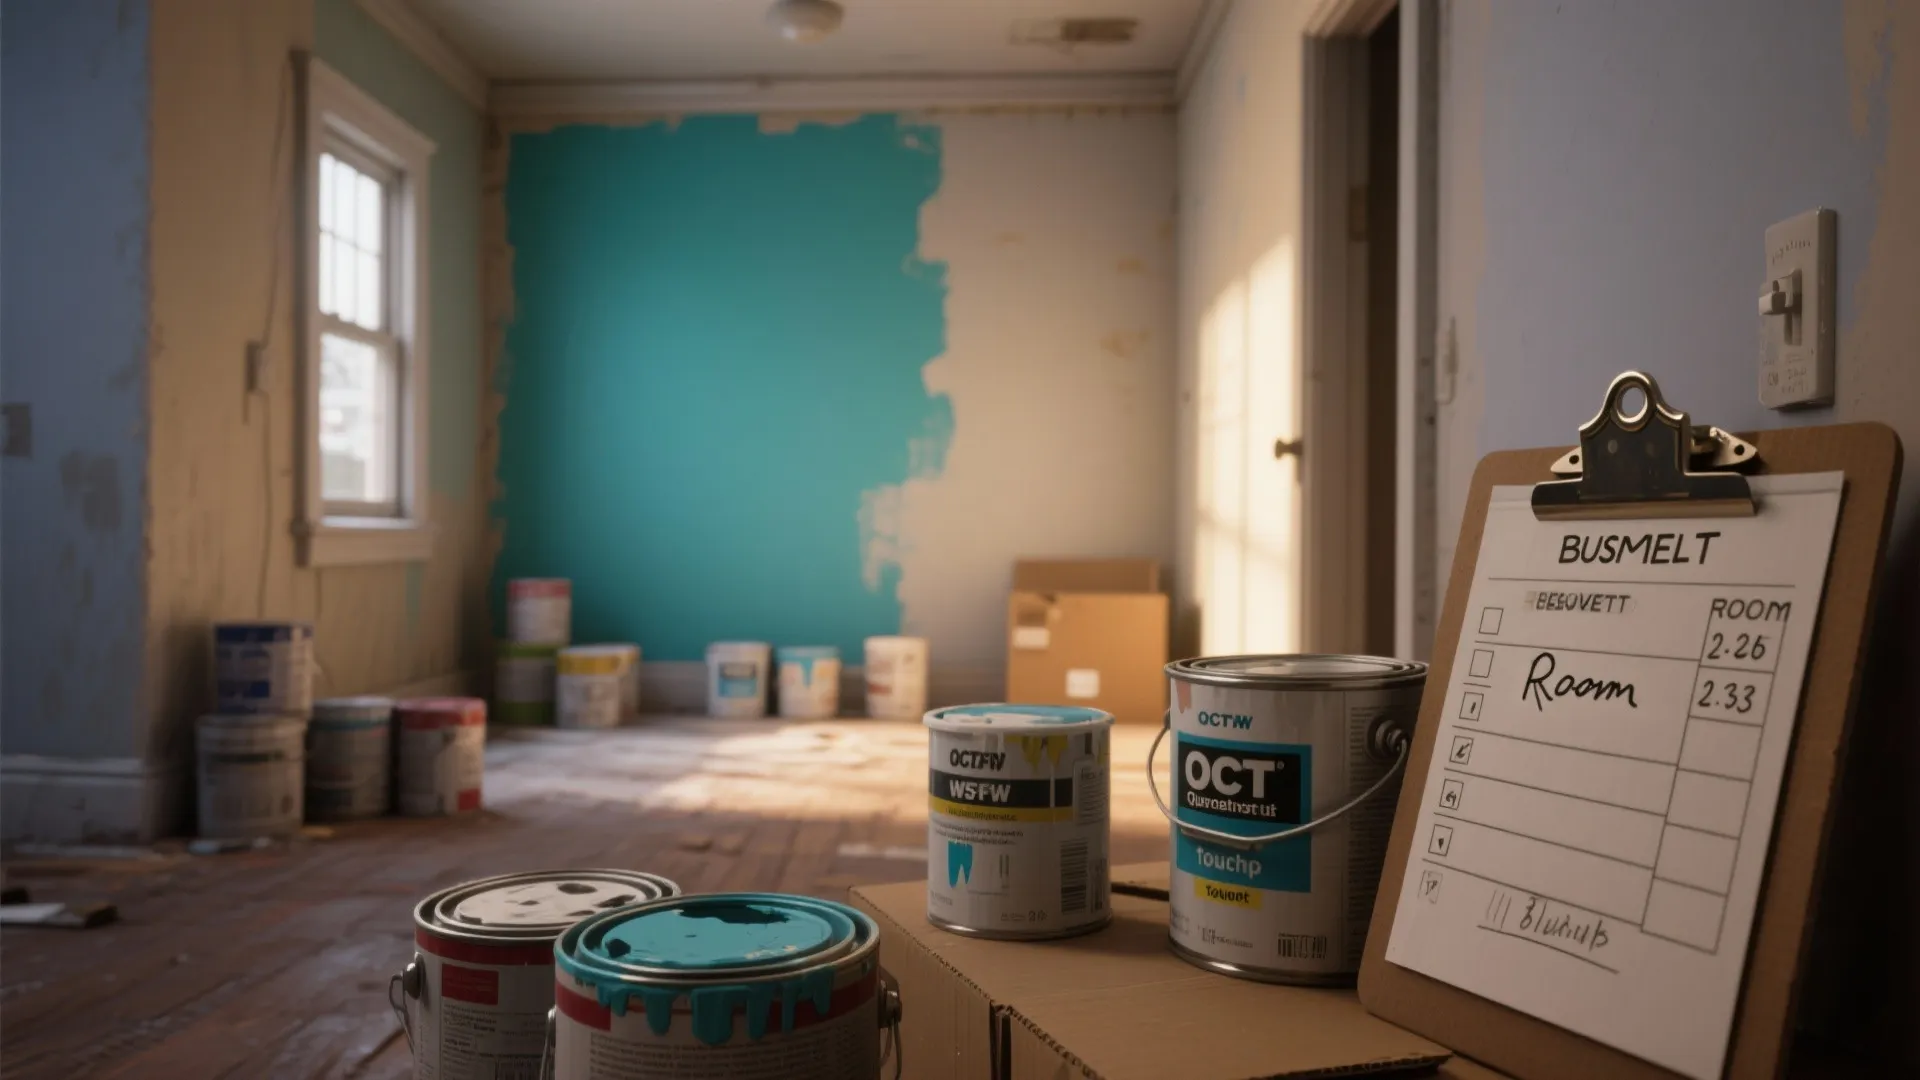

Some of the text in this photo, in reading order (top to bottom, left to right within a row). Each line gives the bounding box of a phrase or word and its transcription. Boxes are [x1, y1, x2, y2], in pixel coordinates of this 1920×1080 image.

[1558, 531, 1721, 565] BUSMELT
[1711, 598, 1792, 622] ROOM
[1522, 652, 1637, 711] Room
[1698, 680, 1756, 713] 2.33
